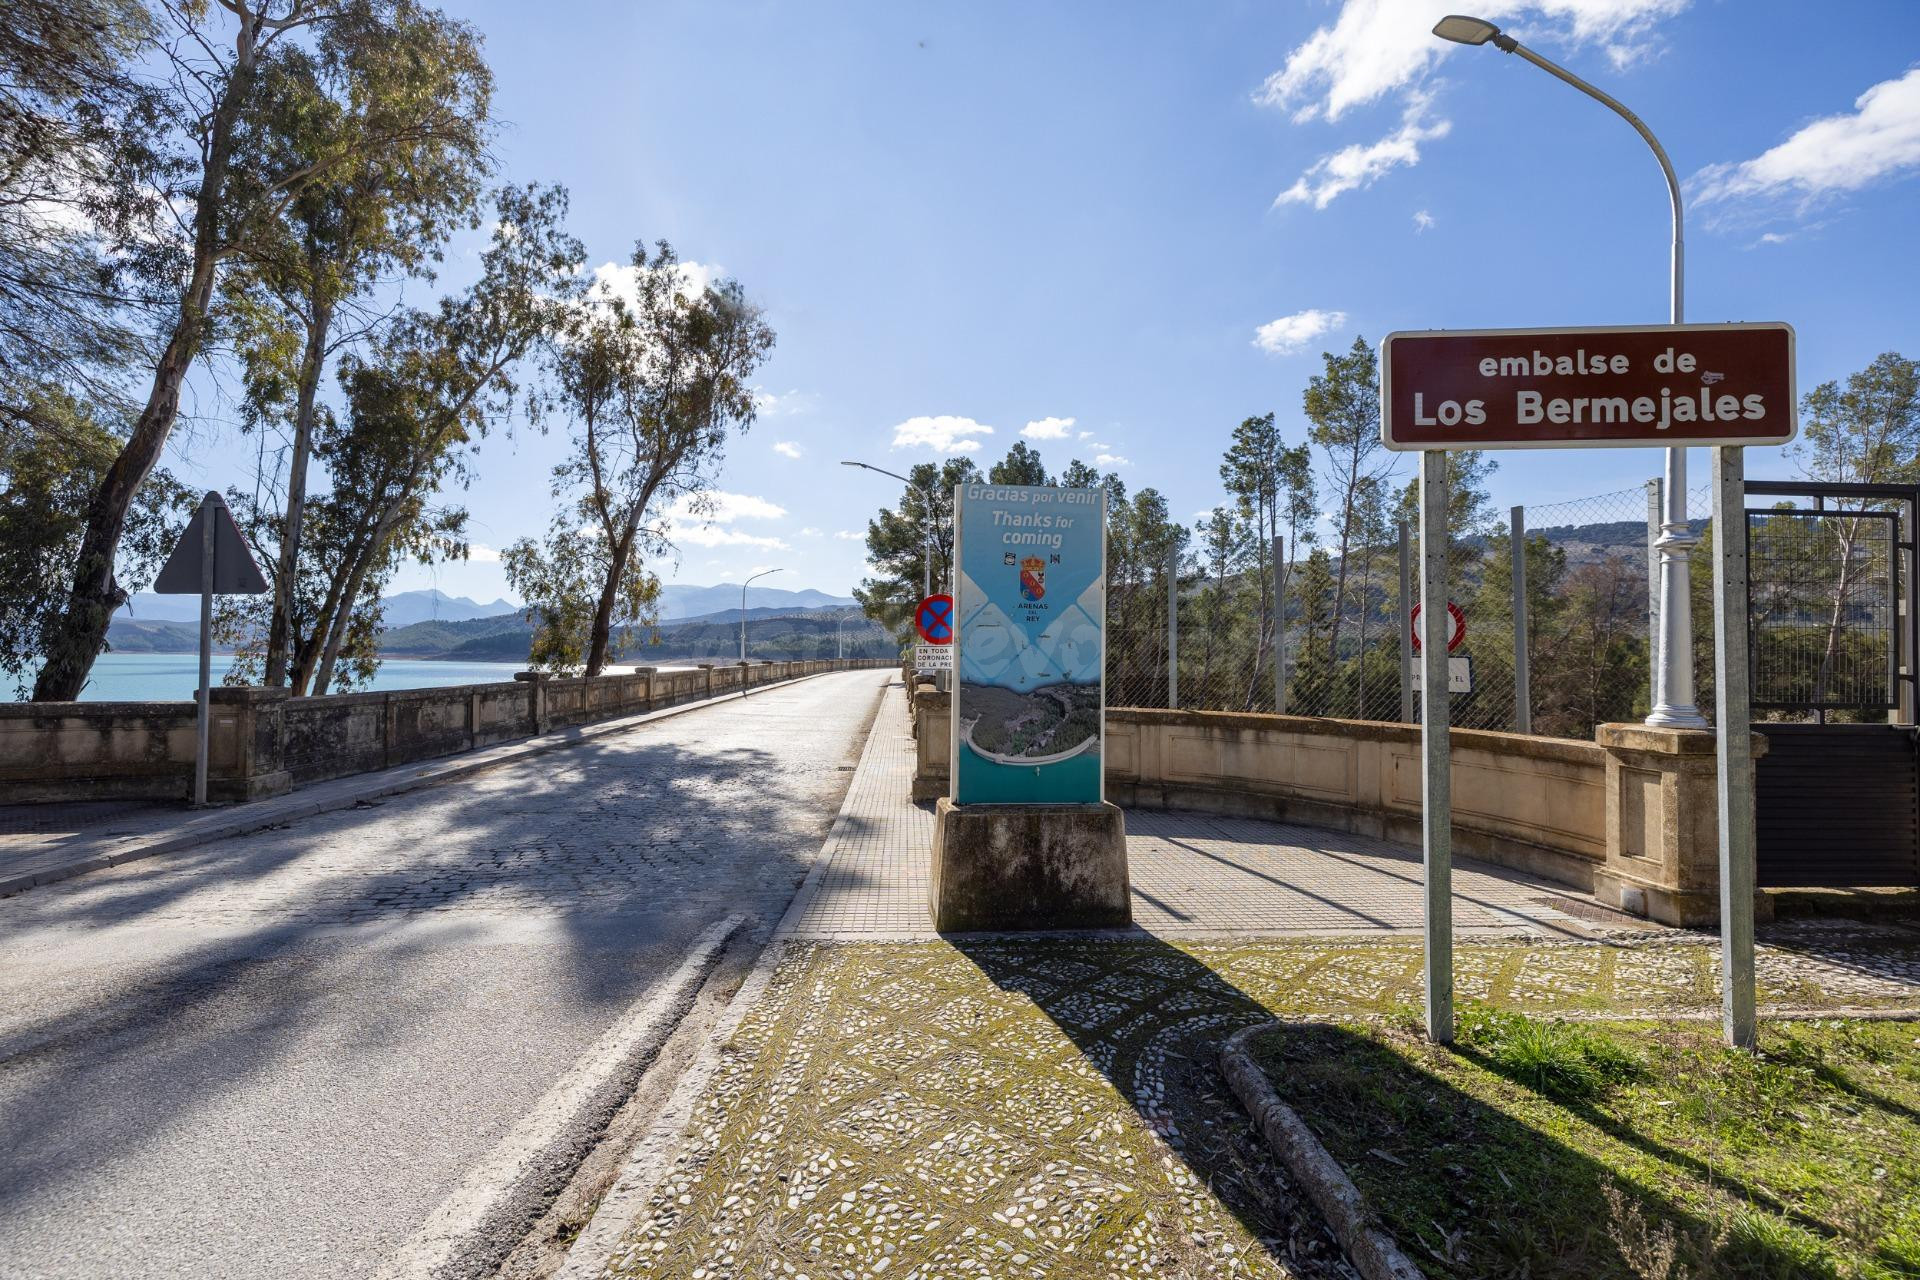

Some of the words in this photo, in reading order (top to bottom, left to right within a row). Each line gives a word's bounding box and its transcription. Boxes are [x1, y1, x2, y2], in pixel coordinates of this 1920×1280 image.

[1478, 348, 1630, 378] embalse
[1653, 347, 1697, 374] de
[1414, 392, 1487, 427] Los
[1516, 386, 1767, 430] Bermejales
[967, 485, 1029, 502] Gracias
[1032, 492, 1055, 506] por
[1057, 488, 1099, 506] venir
[992, 510, 1052, 528] Thanks
[1055, 515, 1075, 529] for
[1002, 529, 1063, 550] coming
